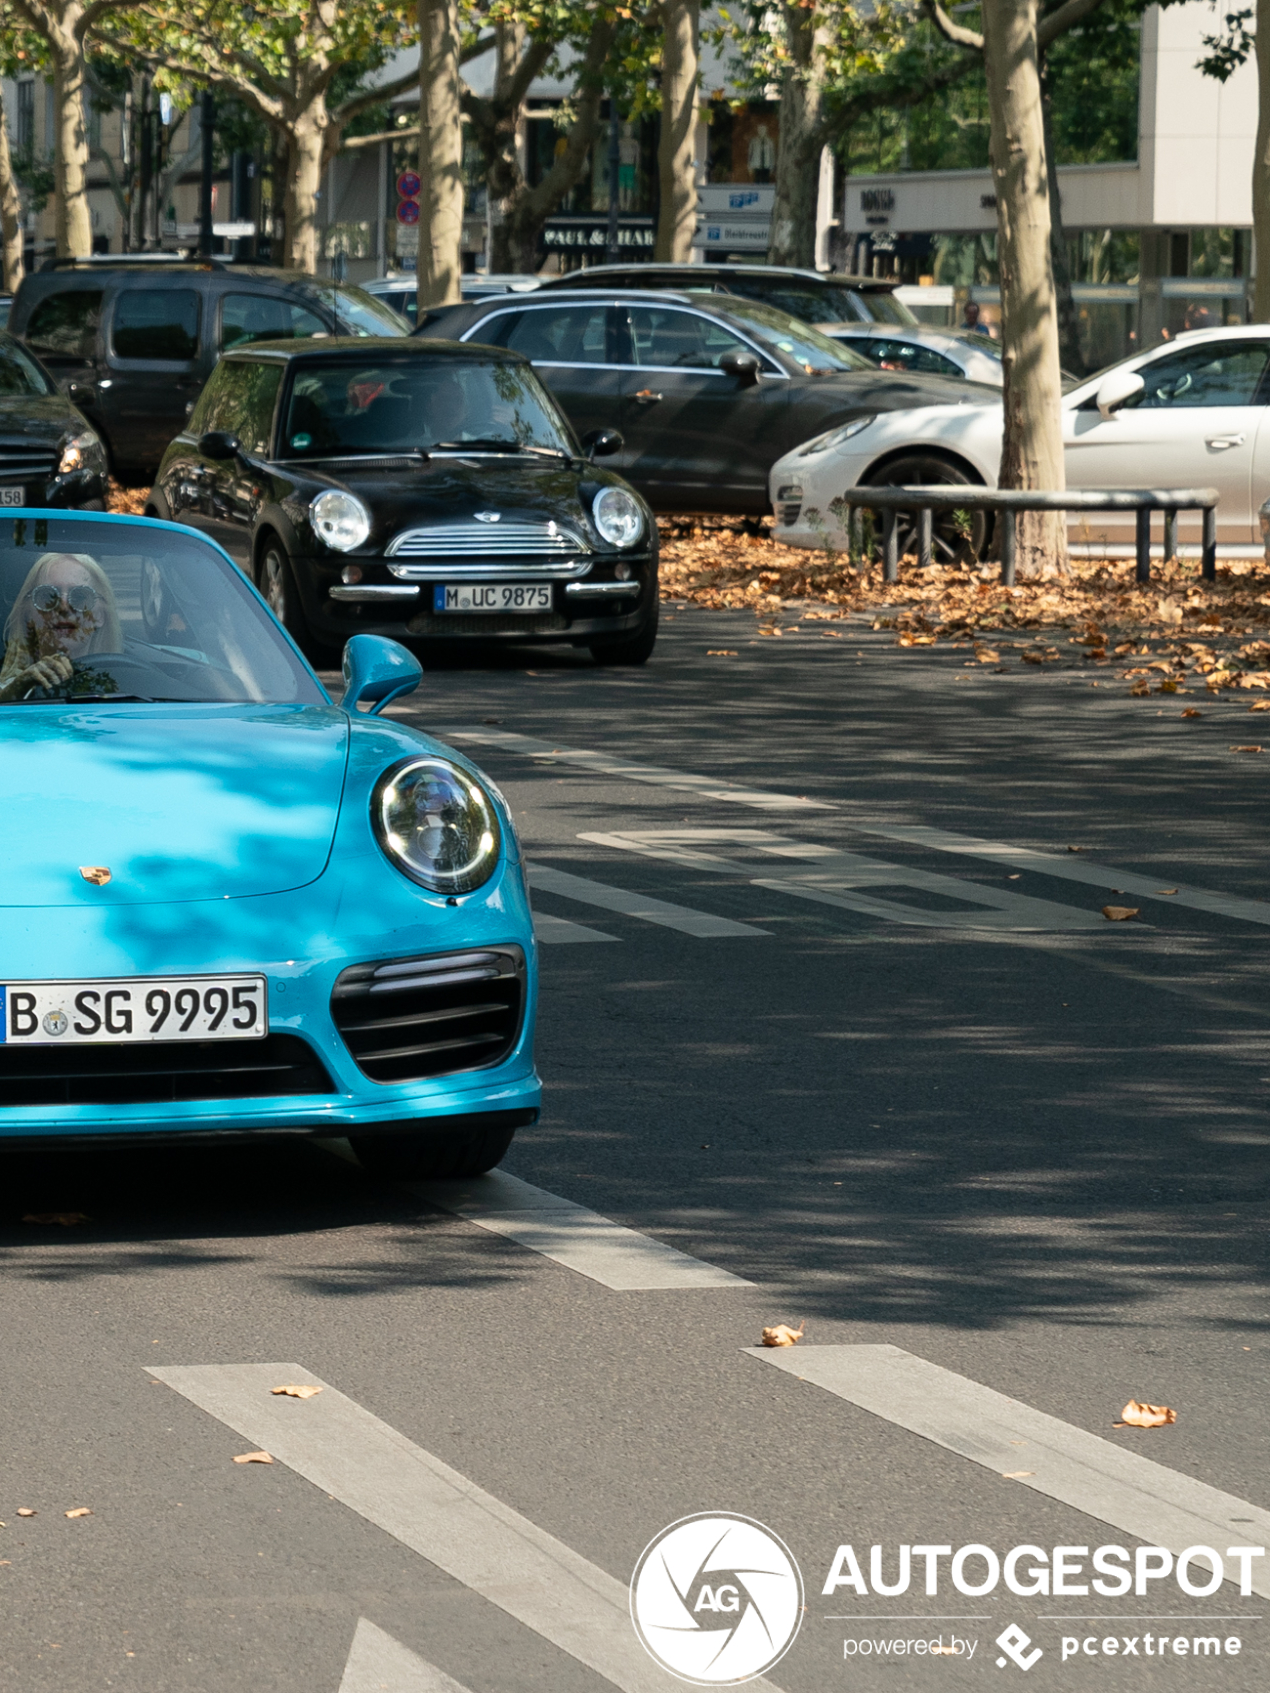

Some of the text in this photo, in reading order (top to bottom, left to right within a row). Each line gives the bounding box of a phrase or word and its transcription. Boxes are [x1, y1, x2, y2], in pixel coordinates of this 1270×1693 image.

[544, 228, 654, 245] PAUL & HAR
[446, 589, 458, 607] M
[472, 588, 497, 607] UC
[502, 587, 549, 606] 9875
[10, 992, 38, 1037] B
[74, 990, 133, 1035] SG
[145, 986, 258, 1033] 9995
